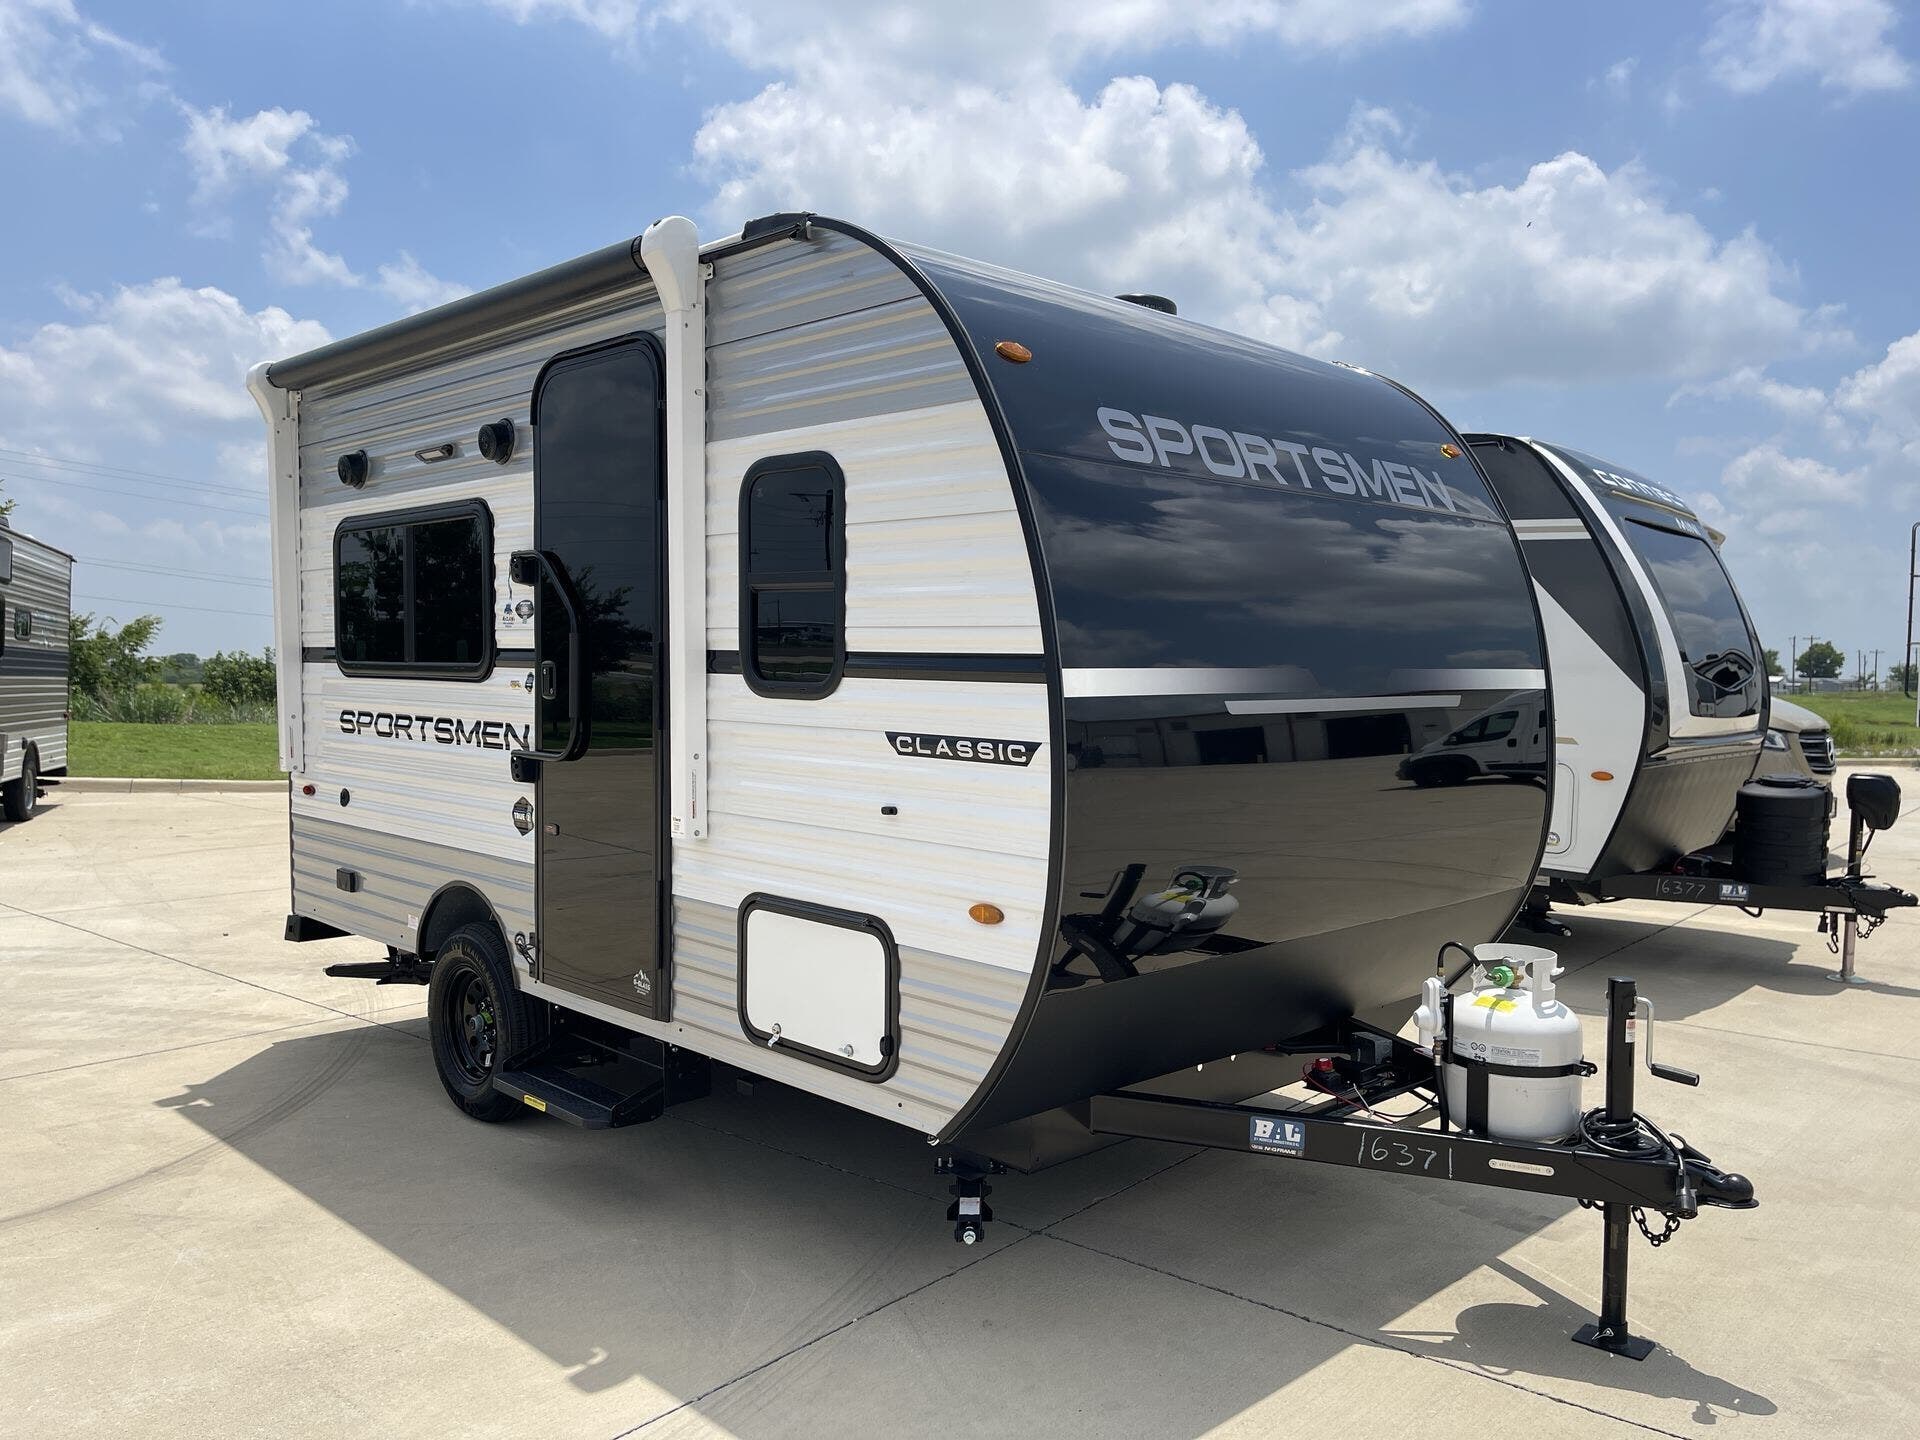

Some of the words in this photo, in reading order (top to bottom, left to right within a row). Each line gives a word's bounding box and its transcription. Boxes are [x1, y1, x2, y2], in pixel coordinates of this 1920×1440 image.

[1096, 406, 1457, 513] SPORTSMEN
[339, 709, 530, 751] SPORTSMEN
[895, 736, 1027, 763] CLASSIC
[1655, 877, 1706, 899] 16377
[1254, 1119, 1301, 1142] BAL
[1358, 1131, 1453, 1180] 16371
